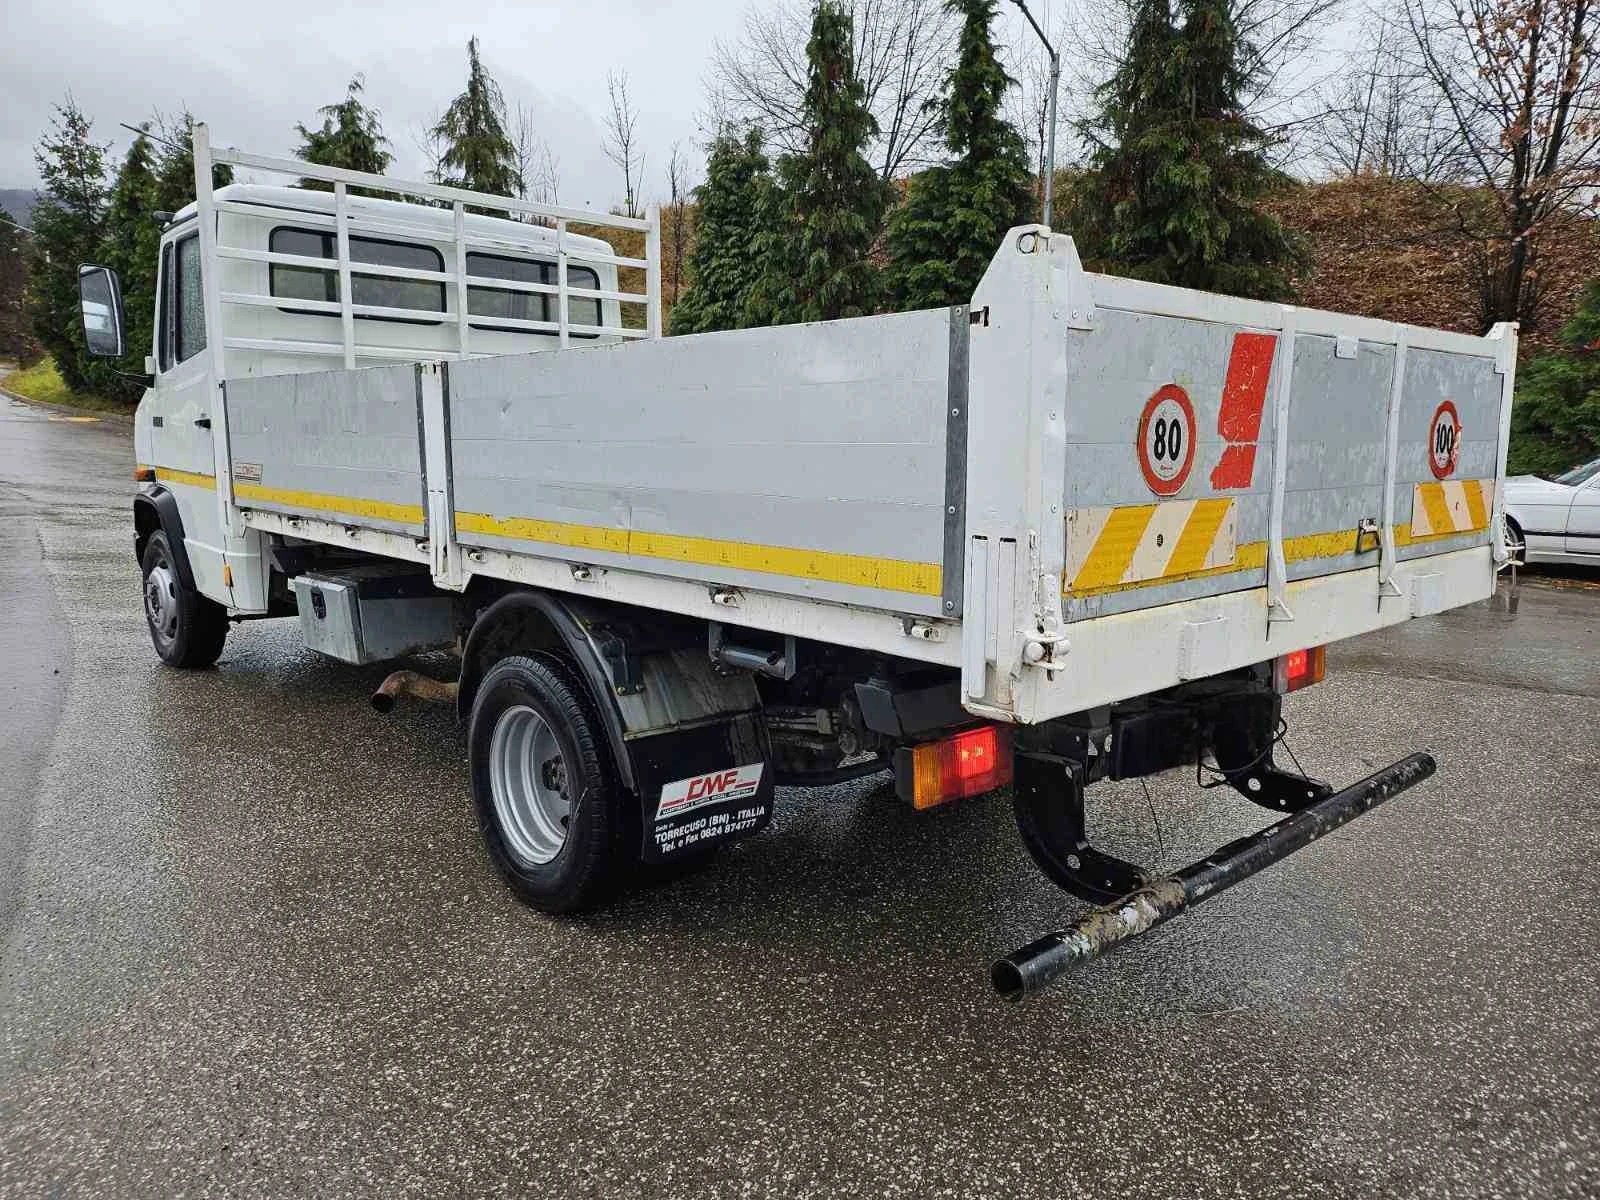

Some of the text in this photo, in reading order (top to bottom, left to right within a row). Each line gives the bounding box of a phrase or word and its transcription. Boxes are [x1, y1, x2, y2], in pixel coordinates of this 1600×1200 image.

[1154, 417, 1182, 461] 80
[1435, 423, 1454, 454] 100
[687, 771, 738, 800] CMF
[654, 818, 707, 845] TORRECUSO
[709, 812, 730, 828] (BN)
[737, 805, 766, 820] ITALIA
[661, 818, 757, 854] Tel. e Fax 0824 874777
